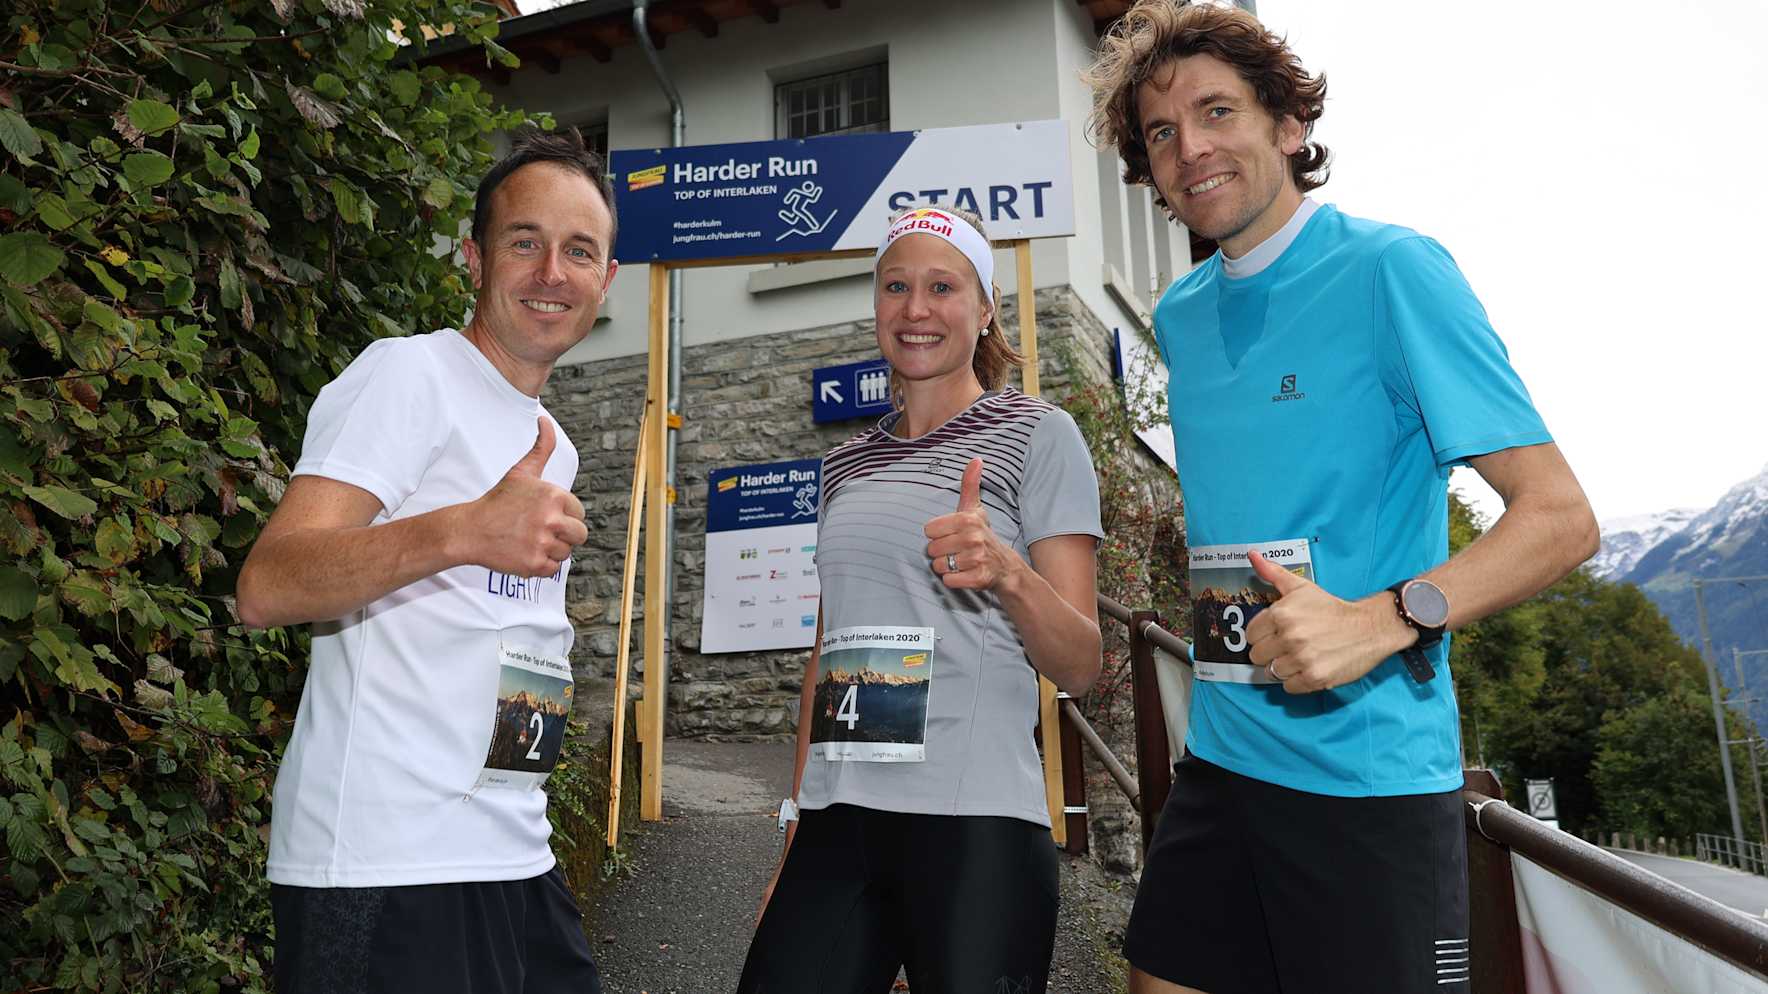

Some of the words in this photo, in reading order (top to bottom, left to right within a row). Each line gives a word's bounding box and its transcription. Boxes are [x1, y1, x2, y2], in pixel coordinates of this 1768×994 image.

[673, 159, 761, 184] Harder
[768, 157, 818, 177] Run
[674, 191, 695, 200] TOP
[697, 189, 711, 199] OF
[713, 185, 778, 198] INTERLAKEN
[673, 219, 722, 229] #harderkulm
[917, 220, 953, 238] Bull
[672, 231, 762, 244] jungfrau.ch/harder-run
[740, 472, 786, 487] Harder
[789, 469, 816, 482] Run
[1217, 552, 1226, 562] Top
[1269, 548, 1294, 559] 2020
[855, 633, 894, 641] Interlaken
[896, 634, 920, 642] 2020
[1222, 604, 1248, 653] 3
[836, 684, 859, 730] 4
[525, 711, 544, 761] 2
